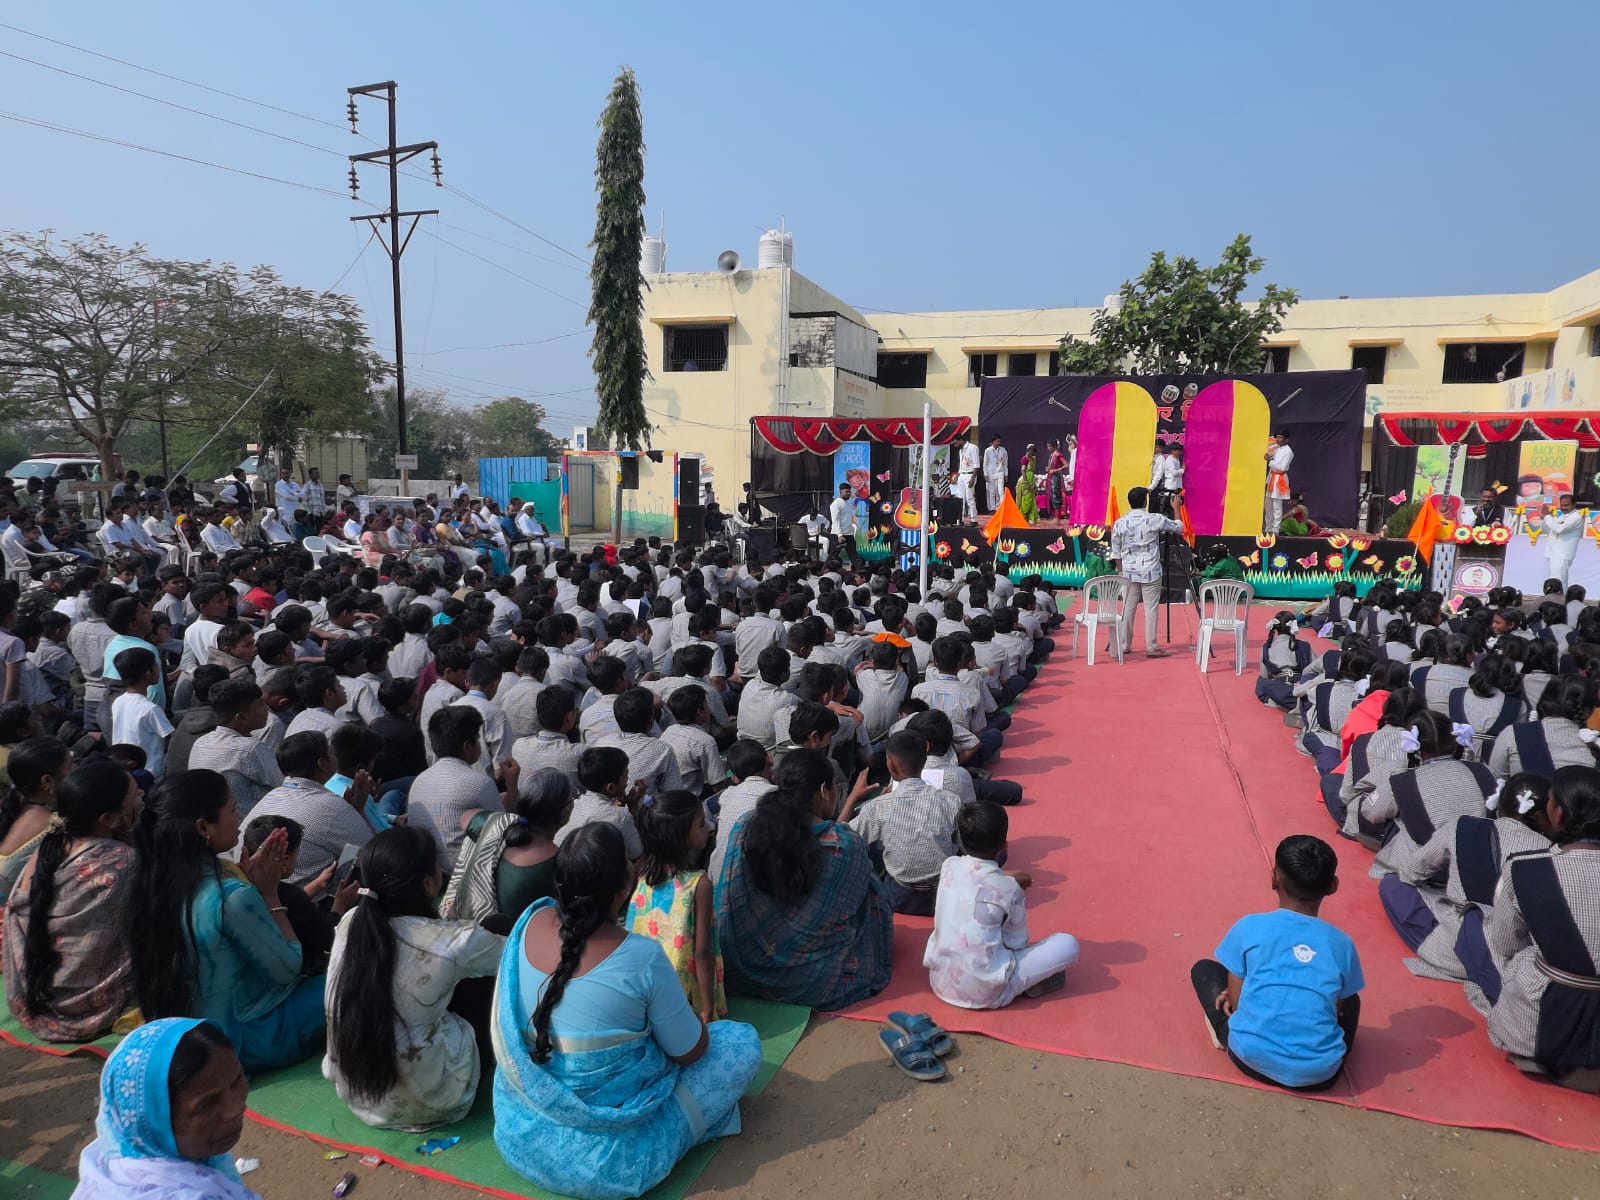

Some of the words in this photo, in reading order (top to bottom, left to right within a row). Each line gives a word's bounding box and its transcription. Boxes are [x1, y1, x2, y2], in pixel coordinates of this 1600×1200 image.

[1533, 445, 1553, 456] BACK
[1556, 445, 1567, 456] TO
[839, 453, 864, 464] SCHOOL
[1529, 456, 1566, 468] SCHOOL
